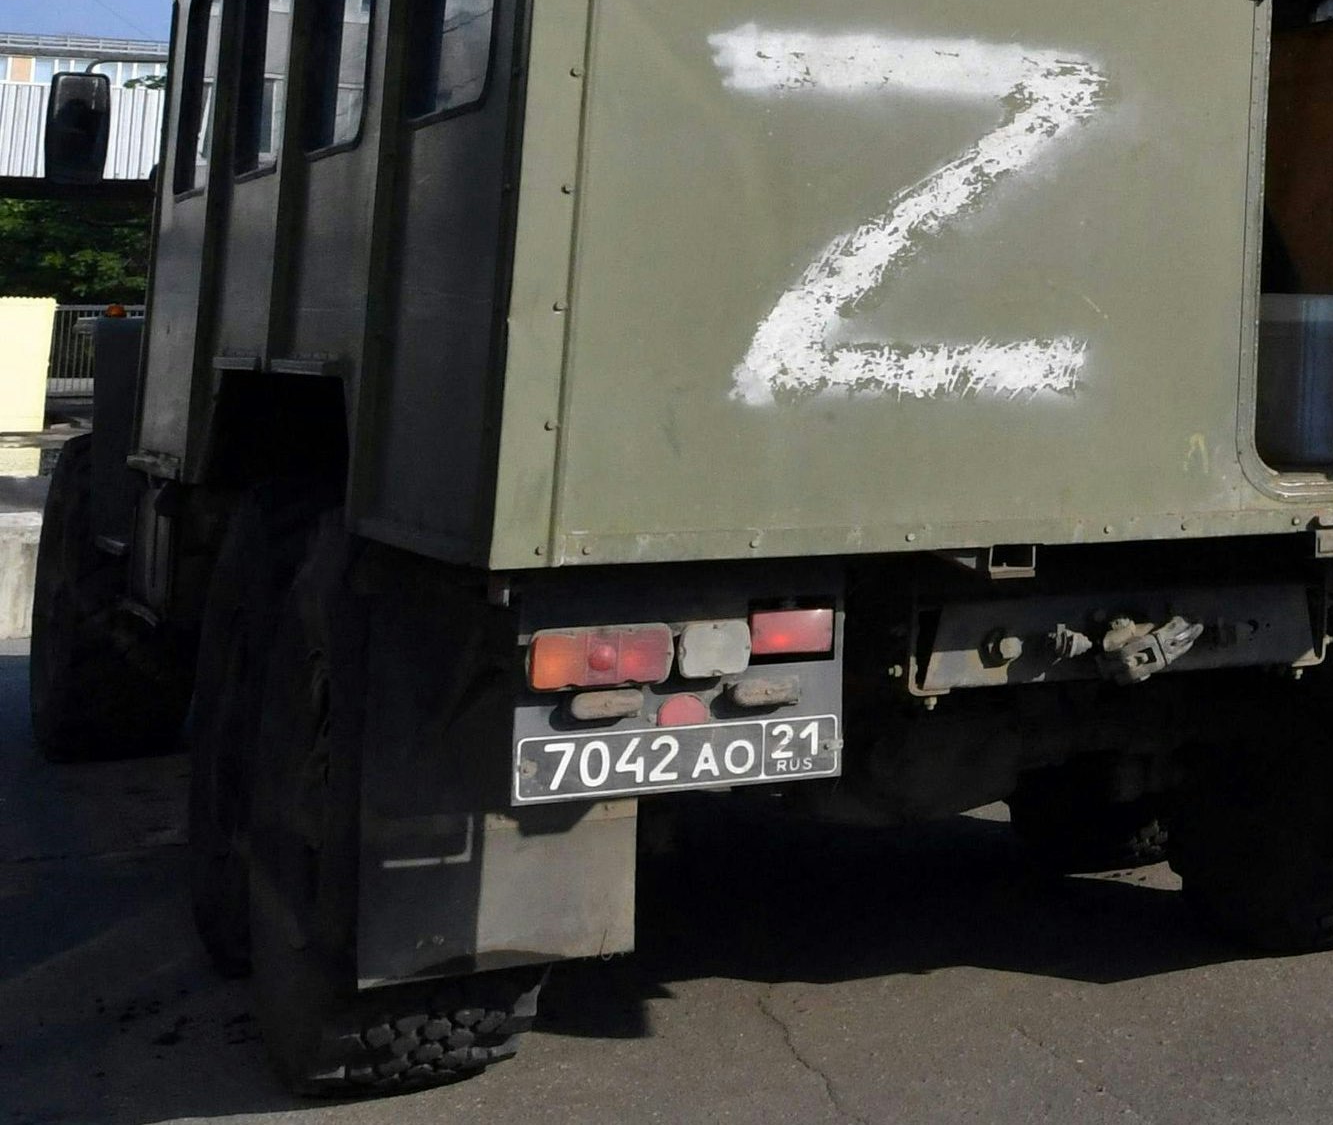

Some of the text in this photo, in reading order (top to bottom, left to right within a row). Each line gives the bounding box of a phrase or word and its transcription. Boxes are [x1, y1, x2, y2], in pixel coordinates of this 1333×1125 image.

[706, 22, 1108, 407] Z
[543, 735, 680, 791] 7042
[770, 722, 821, 760] 21
[776, 757, 814, 773] RUS
